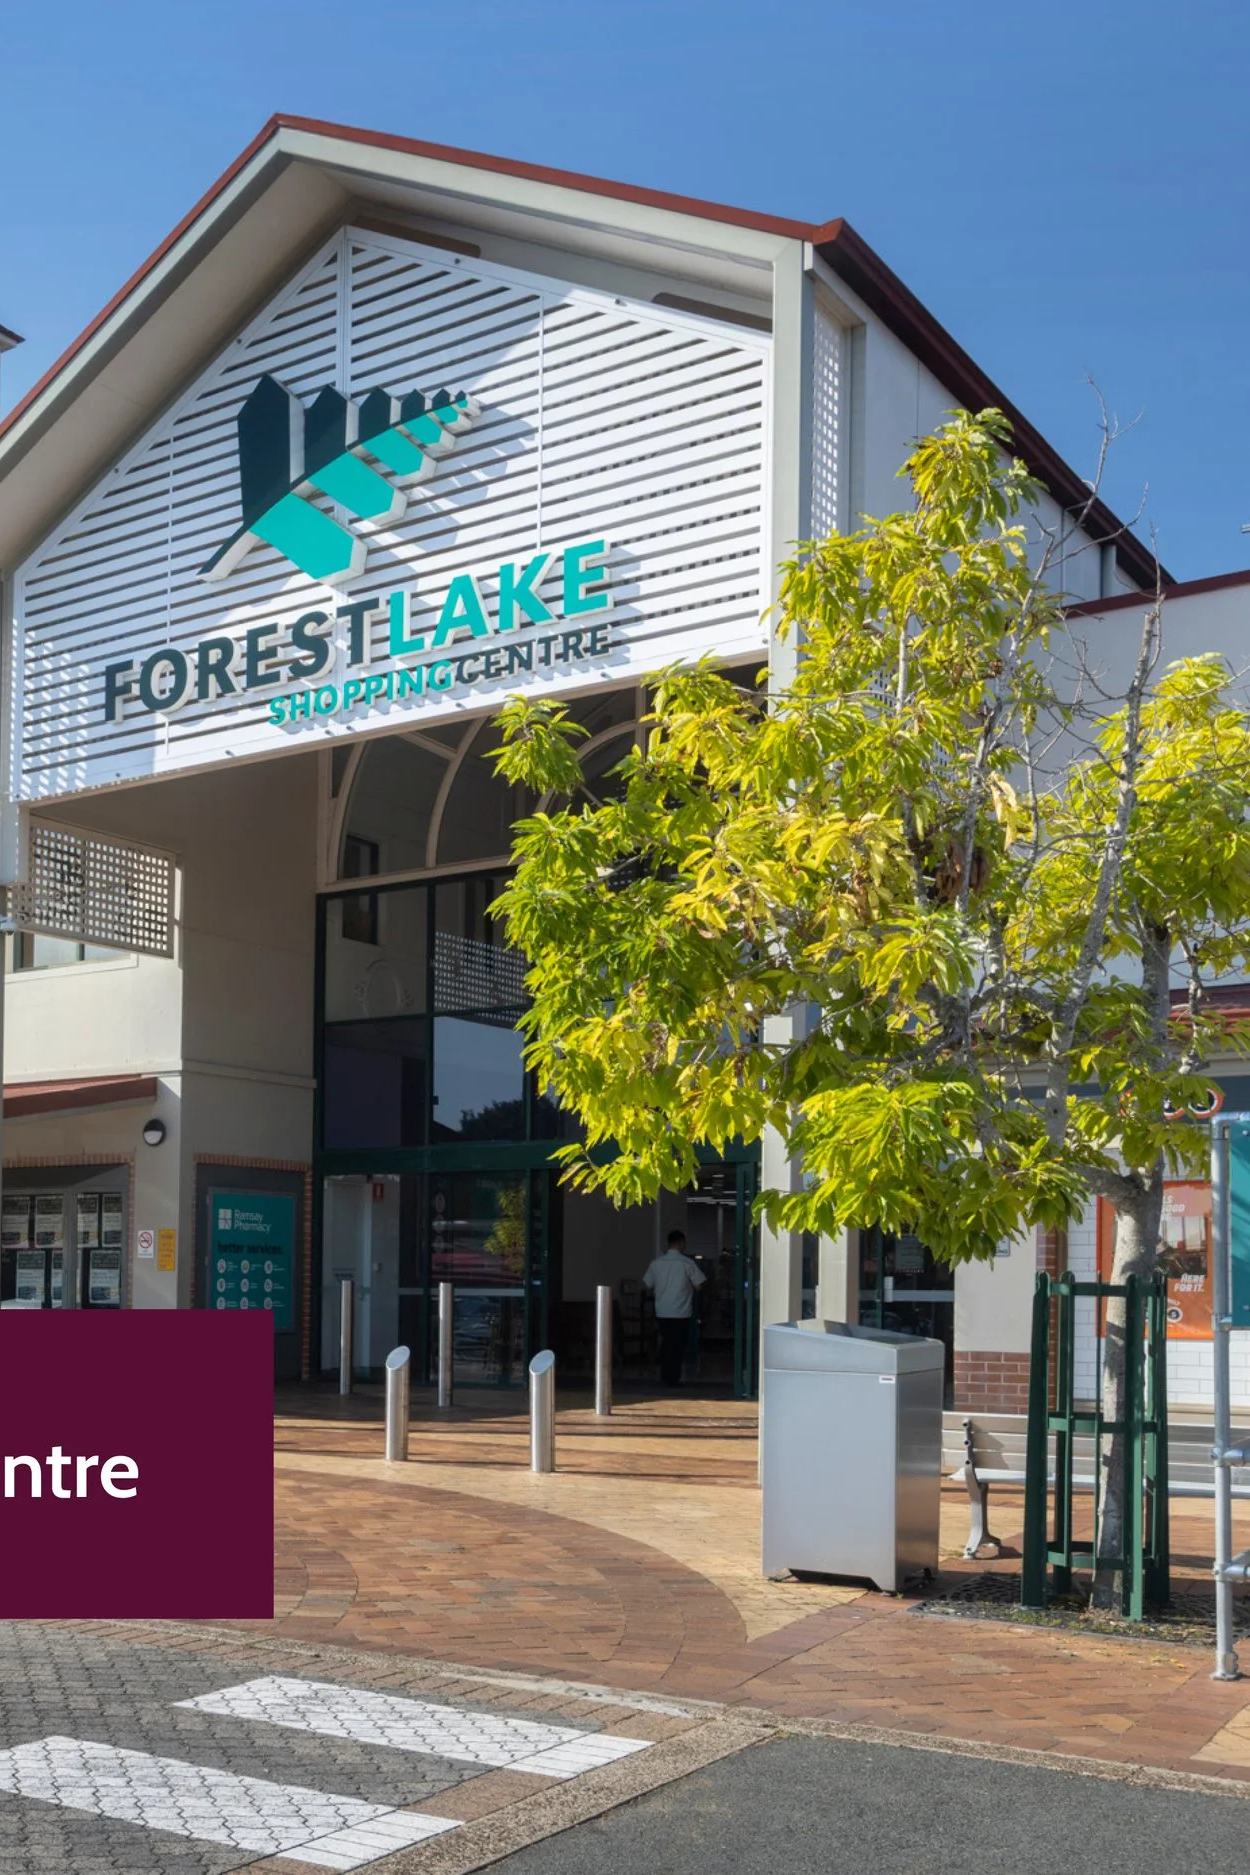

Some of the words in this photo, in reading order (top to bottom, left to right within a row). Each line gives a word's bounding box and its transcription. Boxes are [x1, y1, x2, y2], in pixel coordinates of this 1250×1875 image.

[234, 1209, 263, 1221] Ramsay
[234, 1220, 272, 1234] Pharmacy
[217, 1242, 245, 1254] better
